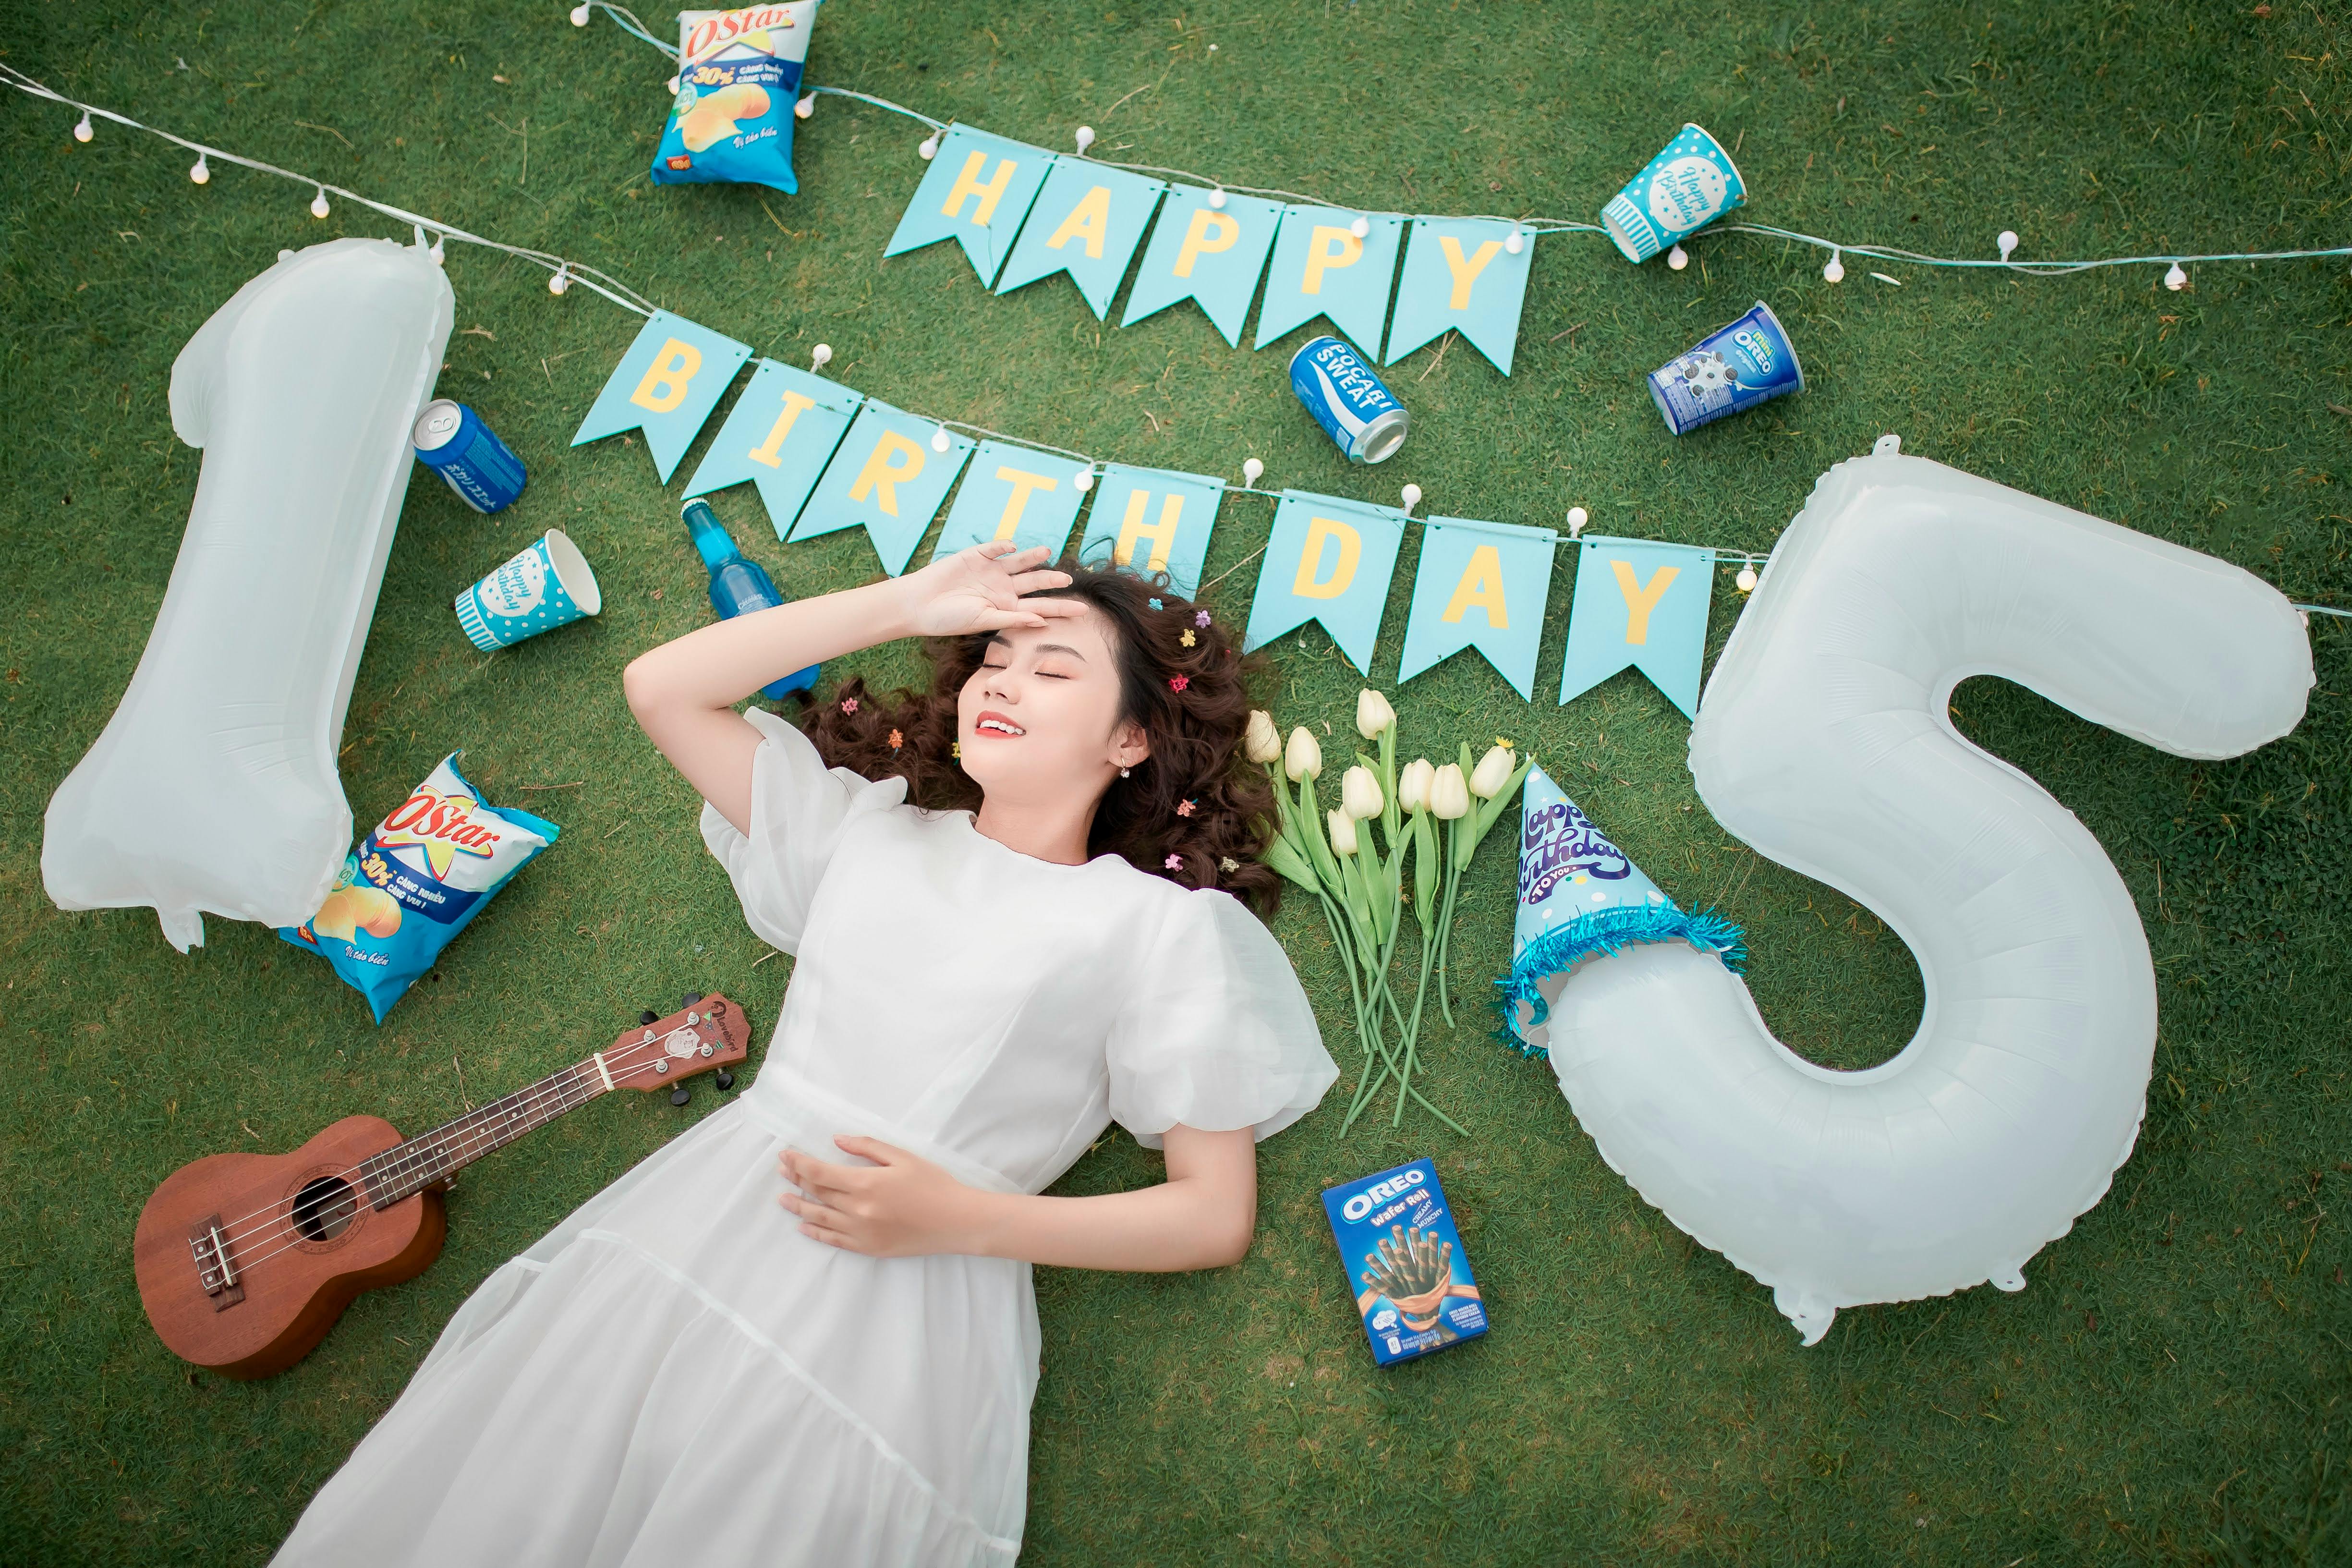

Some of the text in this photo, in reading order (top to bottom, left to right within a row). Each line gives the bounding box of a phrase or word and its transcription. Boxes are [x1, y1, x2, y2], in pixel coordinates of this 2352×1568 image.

[1656, 170, 1697, 226] Birthday
[1678, 167, 1710, 211] Happy
[940, 151, 1505, 310] HAPPY
[1734, 331, 1771, 373] OREO
[1753, 331, 1773, 356] mini
[1317, 348, 1376, 408] SWEAT
[1329, 344, 1393, 408] POCARI
[509, 555, 532, 597] Happy
[384, 795, 500, 848] O'Star
[387, 884, 406, 899] CÀNG
[396, 875, 446, 904] CÀNG NHIỀU
[1532, 867, 1569, 897] TO YOU
[345, 946, 389, 966] Vị tảo biển
[1344, 1170, 1424, 1220] OREO
[1370, 1189, 1430, 1226] Wafer Roll
[1412, 1199, 1433, 1224] CREAMY
[1417, 1208, 1443, 1229] MUNCHY
